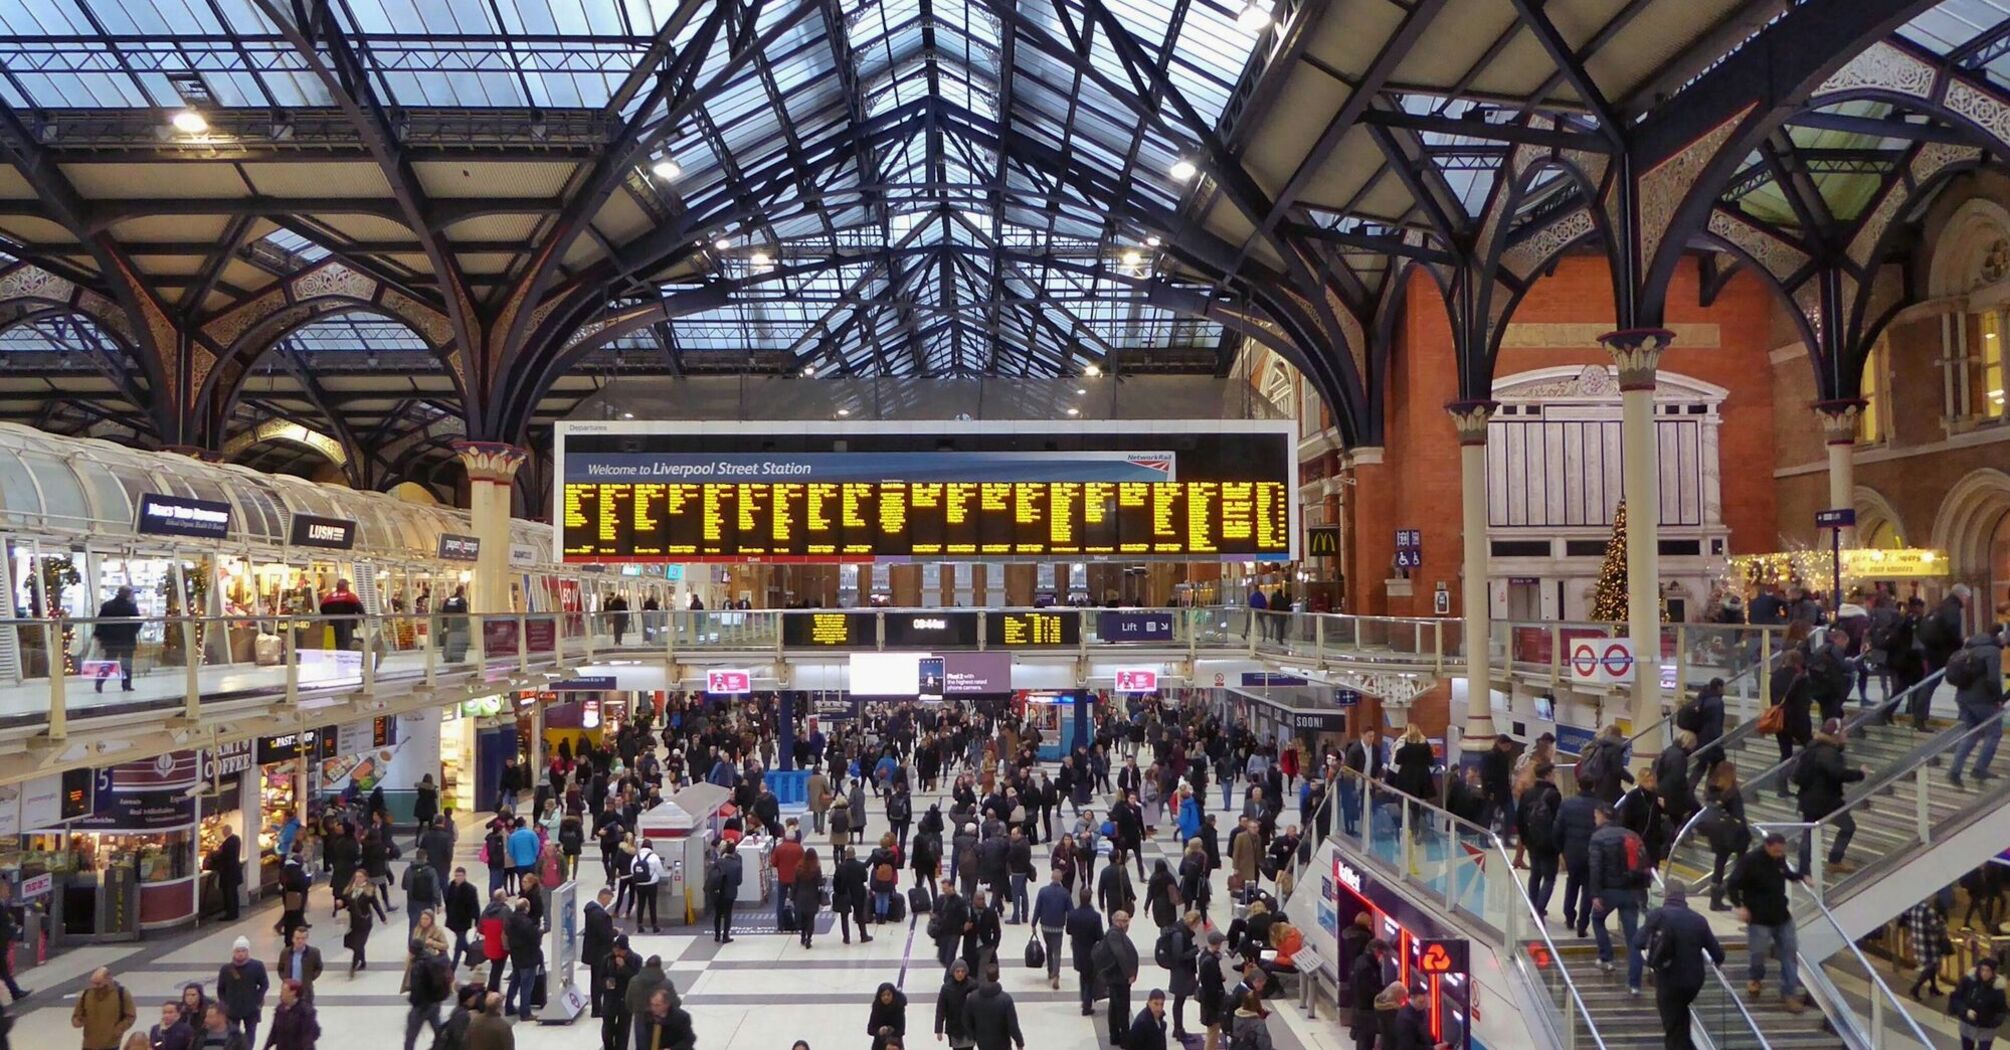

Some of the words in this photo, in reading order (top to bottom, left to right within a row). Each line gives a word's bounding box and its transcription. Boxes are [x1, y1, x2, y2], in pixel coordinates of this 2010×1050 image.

[569, 424, 608, 432] Departures
[588, 464, 637, 475] Welcome
[639, 465, 651, 475] to
[652, 462, 715, 477] Liverpool
[717, 462, 758, 475] Street
[762, 462, 811, 475] Station
[308, 524, 333, 540] LUSH
[1121, 622, 1138, 631] Lift
[1296, 717, 1323, 728] SOON!
[98, 768, 109, 791] 5
